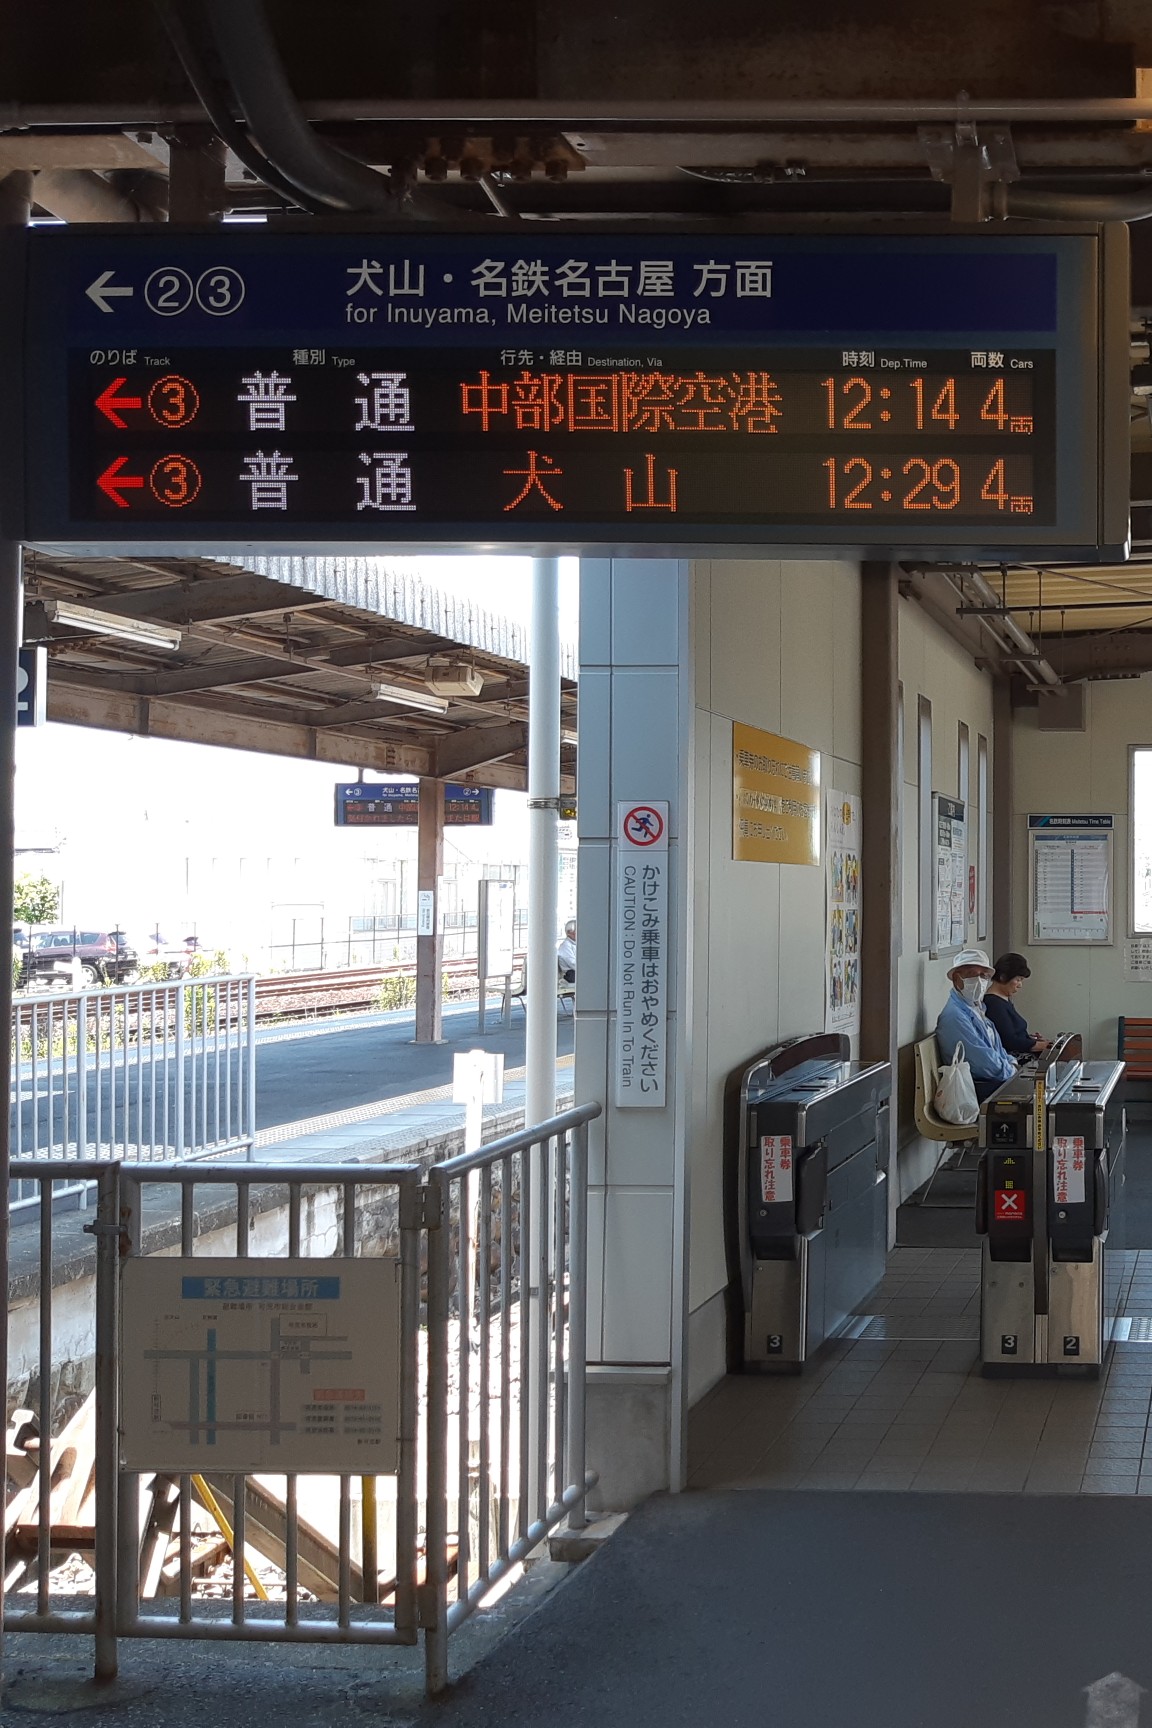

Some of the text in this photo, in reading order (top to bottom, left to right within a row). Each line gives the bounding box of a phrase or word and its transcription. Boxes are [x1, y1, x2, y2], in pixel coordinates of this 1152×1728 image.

[346, 258, 773, 299] 犬山・名鉄名古屋 方面
[346, 303, 711, 329] for Inuyama, Meitetsu Nagoya
[89, 349, 171, 367] のりば Track
[292, 349, 356, 369] 種別 Type
[500, 349, 663, 369] 行先・経由 Destination, Via
[842, 351, 875, 368] 時刻
[970, 351, 1034, 369] 両数 Cars
[460, 370, 783, 434] 中部国際空港
[821, 377, 960, 430] 12:14
[822, 457, 960, 511] 12:29
[624, 940, 635, 959] Do
[624, 963, 636, 986] Not
[640, 864, 660, 1093] かけこみ乗車はおやめください
[623, 991, 635, 1017] Run
[622, 1021, 634, 1034] In
[622, 1037, 634, 1053] To
[621, 1055, 634, 1088] Train
[780, 1137, 791, 1169] 乗車券
[1073, 1138, 1084, 1171] 乗車券
[764, 1137, 776, 1201] 取り忘れ注意
[1057, 1138, 1068, 1202] 取り忘れ注意
[770, 1335, 780, 1348] 3
[1004, 1336, 1015, 1349] 3
[1066, 1336, 1076, 1349] 2
